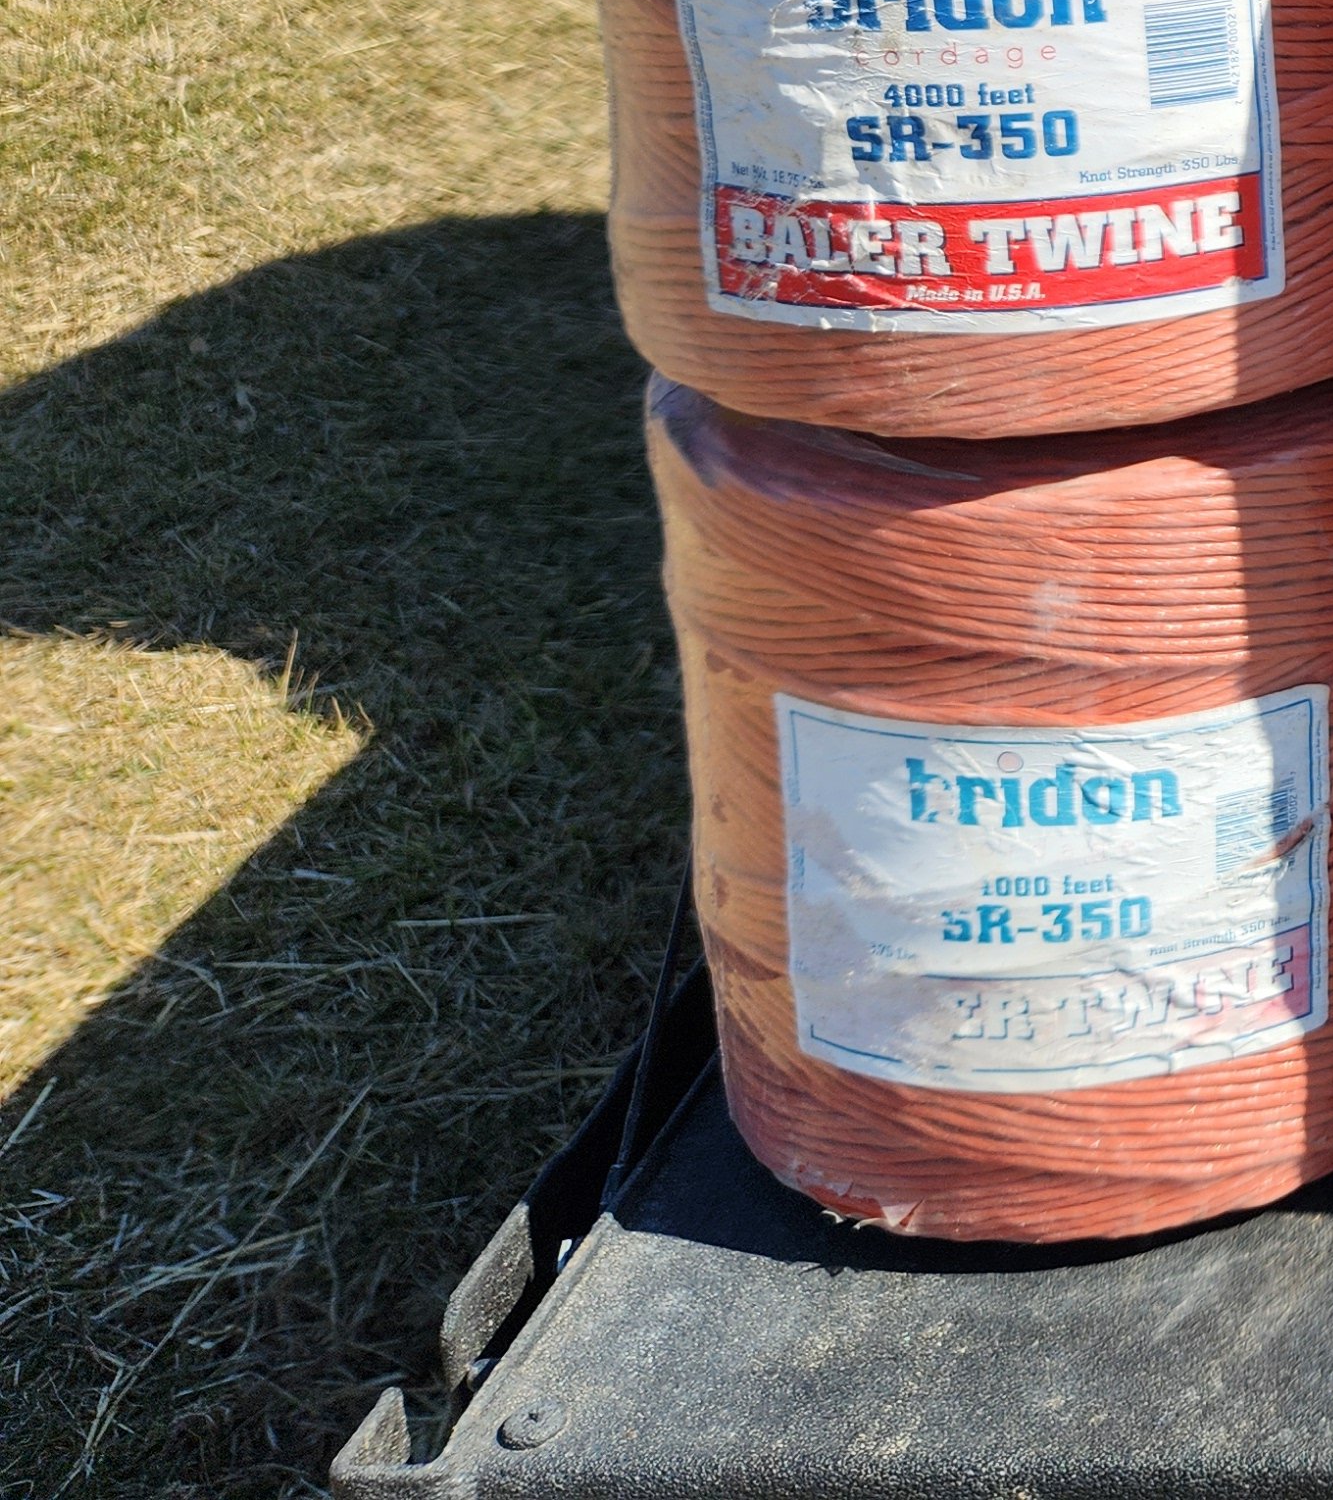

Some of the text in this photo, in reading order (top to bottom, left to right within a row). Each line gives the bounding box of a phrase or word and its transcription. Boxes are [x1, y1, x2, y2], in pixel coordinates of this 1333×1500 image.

[856, 42, 1058, 69] cordage
[884, 82, 1036, 108] 4000 feet
[846, 109, 1081, 164] SR-350
[1079, 170, 1112, 184] Knot
[1117, 163, 1177, 182] Strength
[1181, 157, 1211, 172] 350
[731, 191, 1245, 277] BALER TWINE
[906, 282, 1046, 302] Made in U.S.A.
[941, 896, 1153, 944] SR-350
